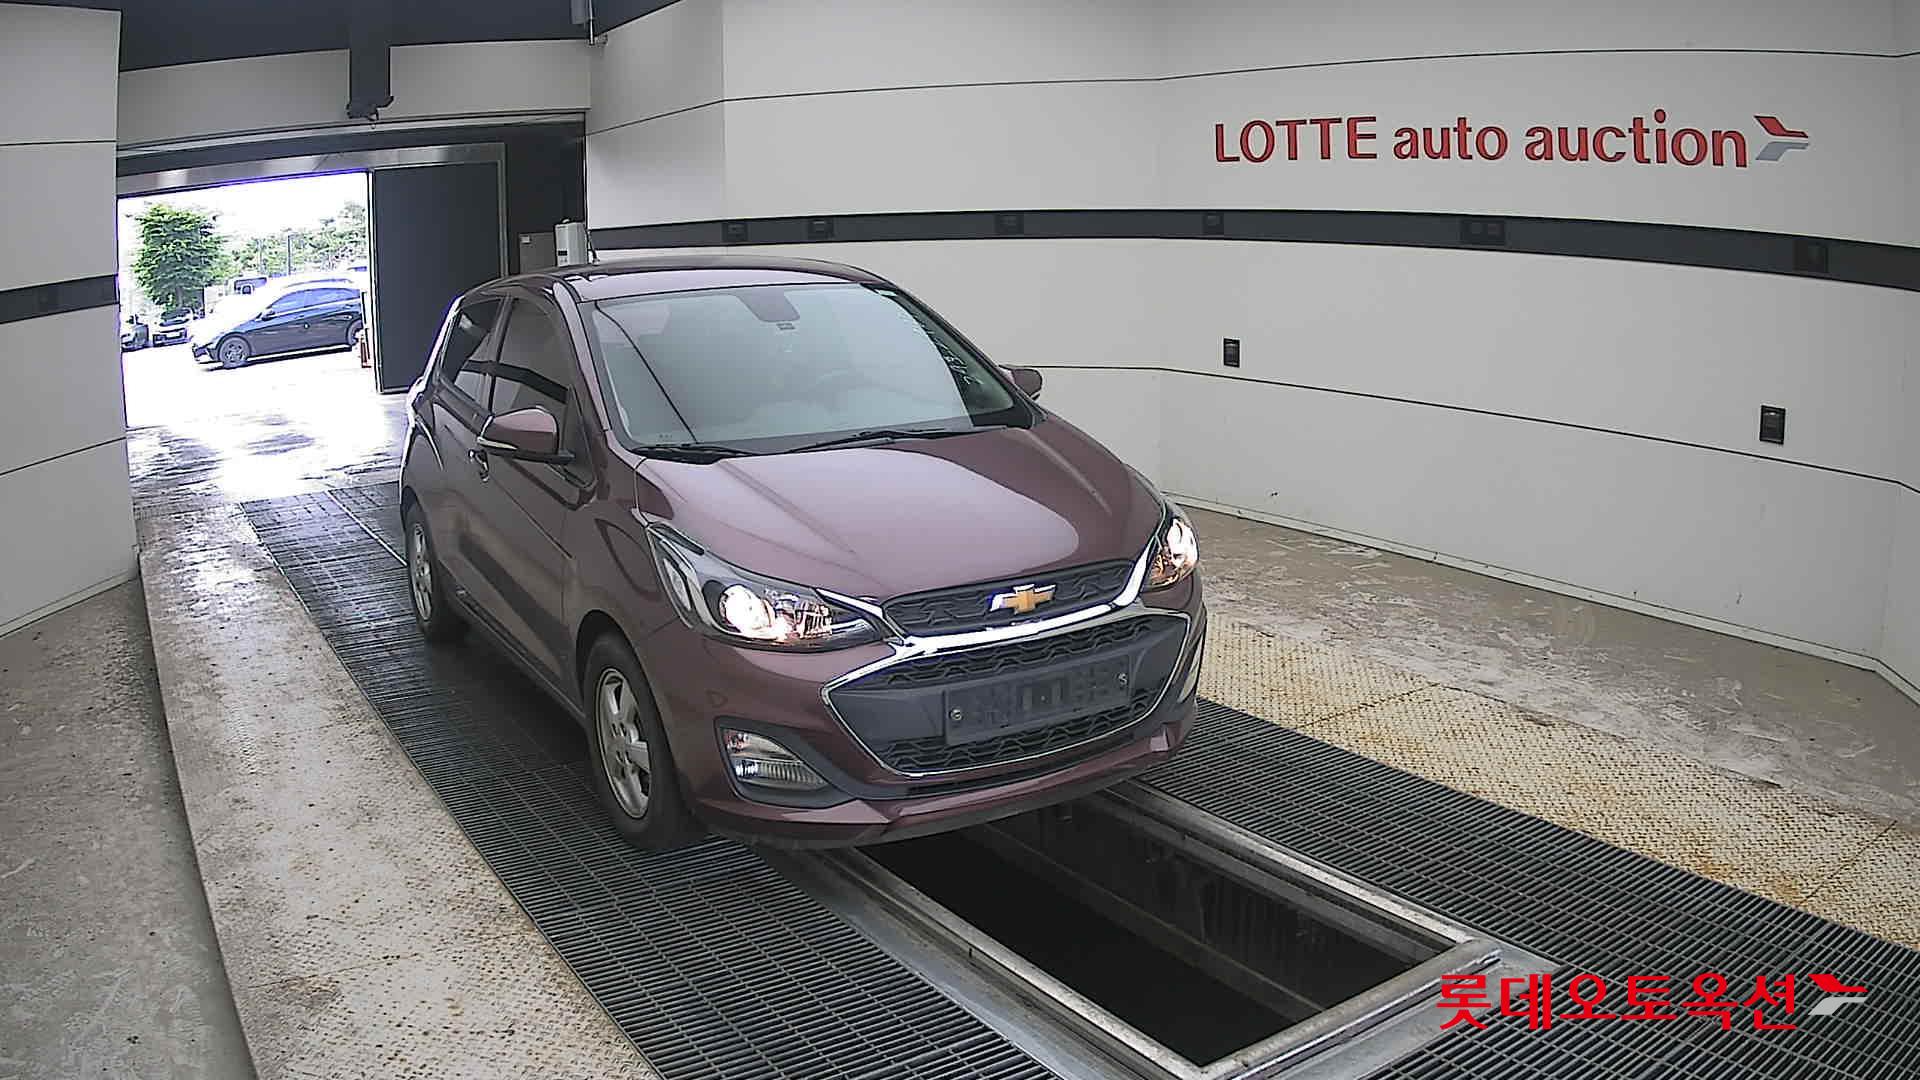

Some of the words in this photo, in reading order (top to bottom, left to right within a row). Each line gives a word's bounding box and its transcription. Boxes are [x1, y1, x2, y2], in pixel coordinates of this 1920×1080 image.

[1215, 116, 1377, 163] LOTTE
[1392, 117, 1509, 161] auto
[1523, 110, 1748, 168] auction
